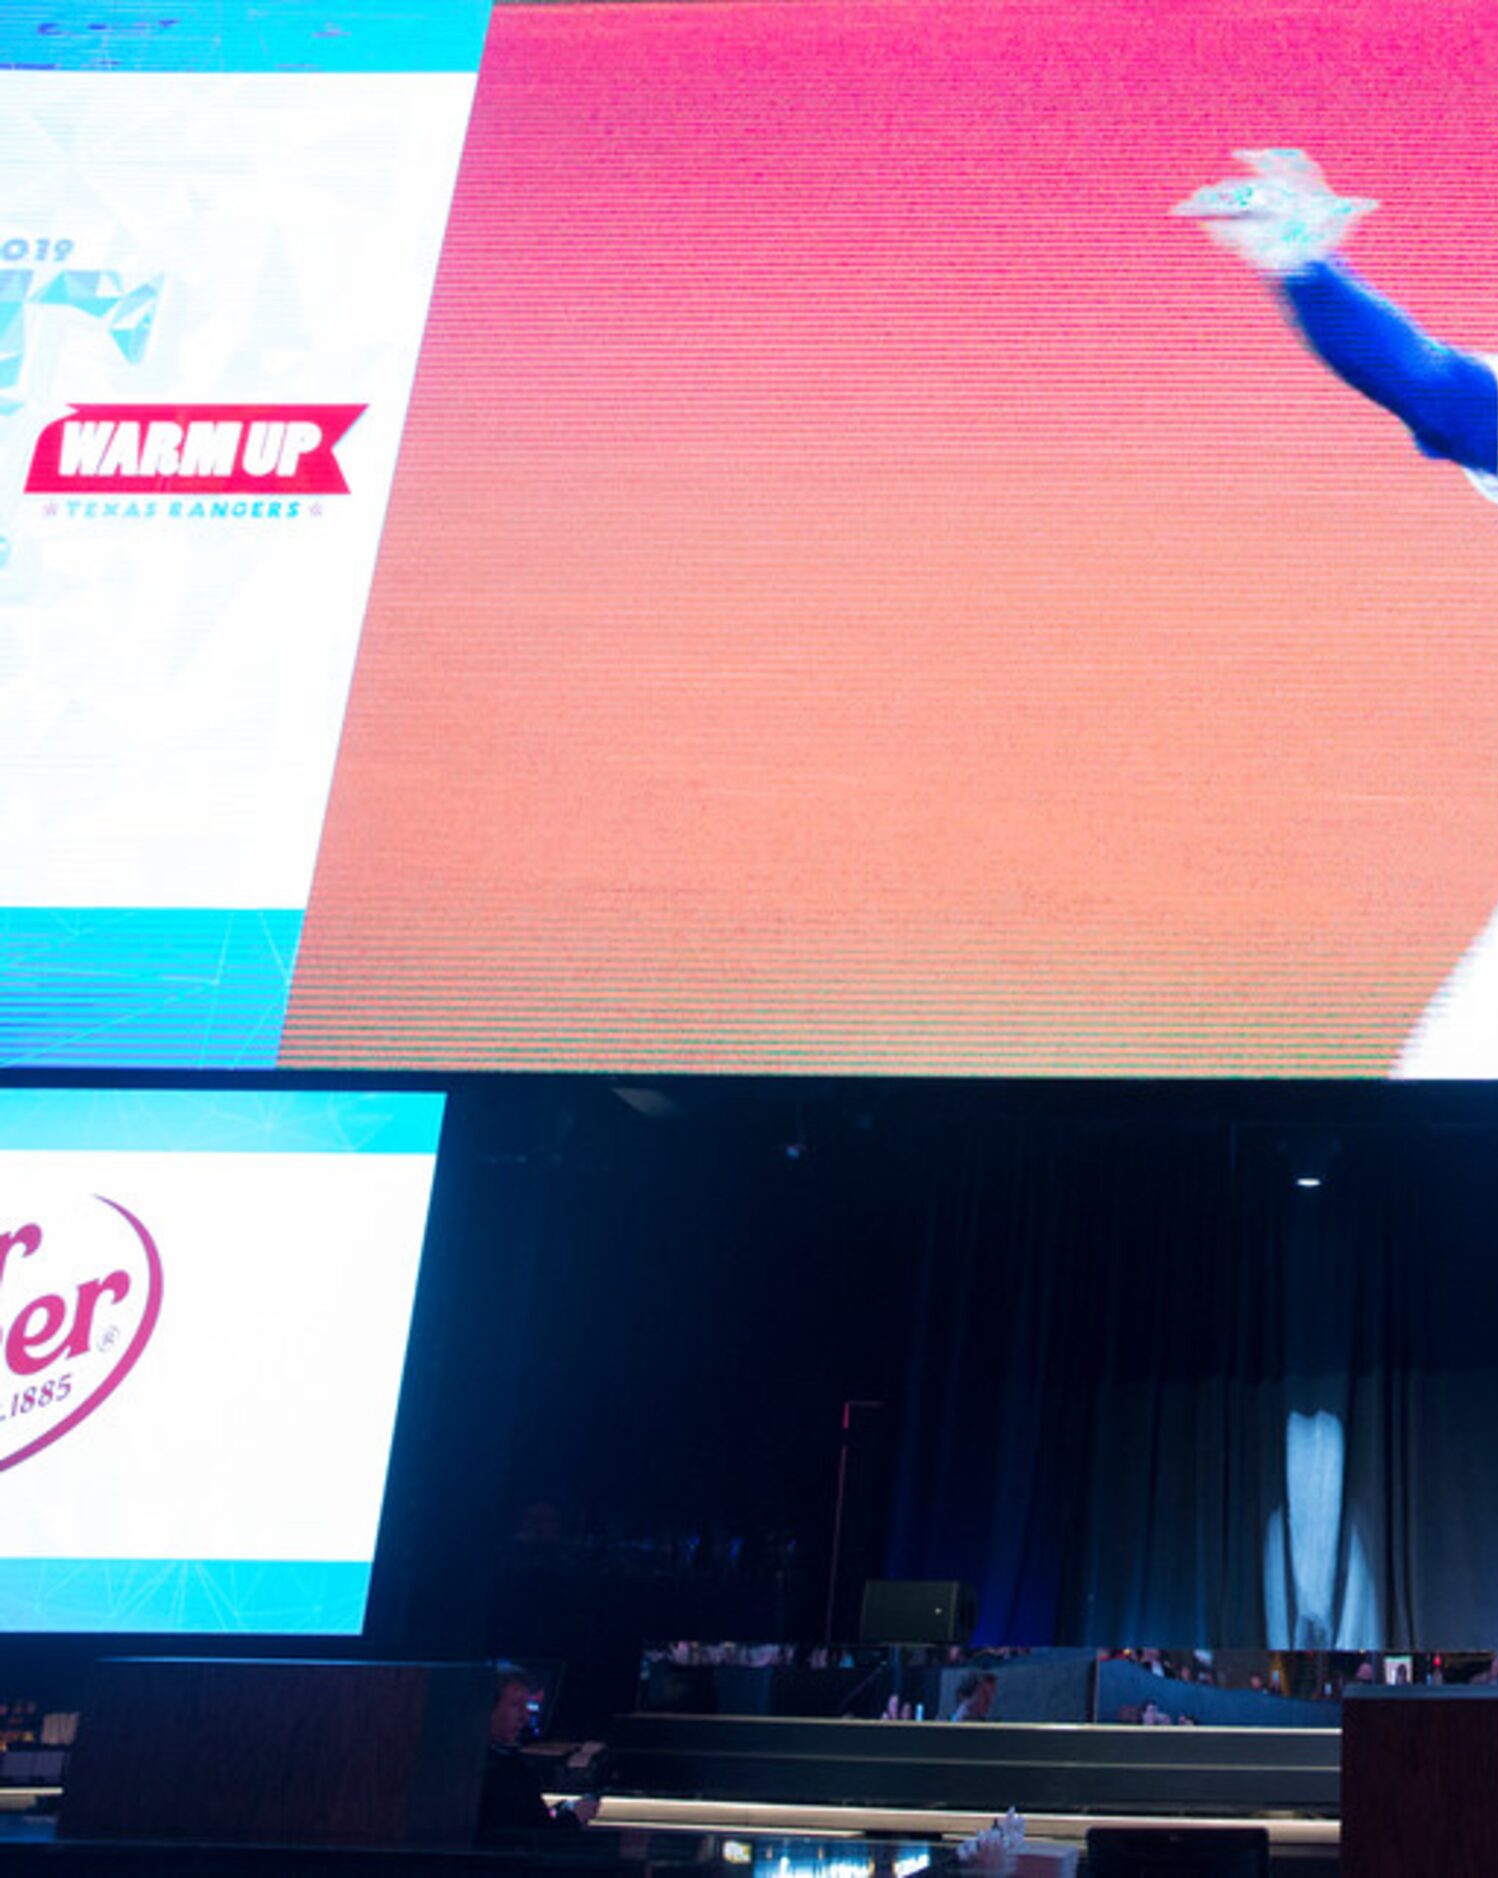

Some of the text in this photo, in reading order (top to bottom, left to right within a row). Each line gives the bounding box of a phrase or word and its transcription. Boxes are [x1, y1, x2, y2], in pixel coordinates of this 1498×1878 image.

[0, 237, 75, 261] 019
[58, 420, 323, 477] WARM UP
[66, 501, 300, 518] TEXAS RANGERS
